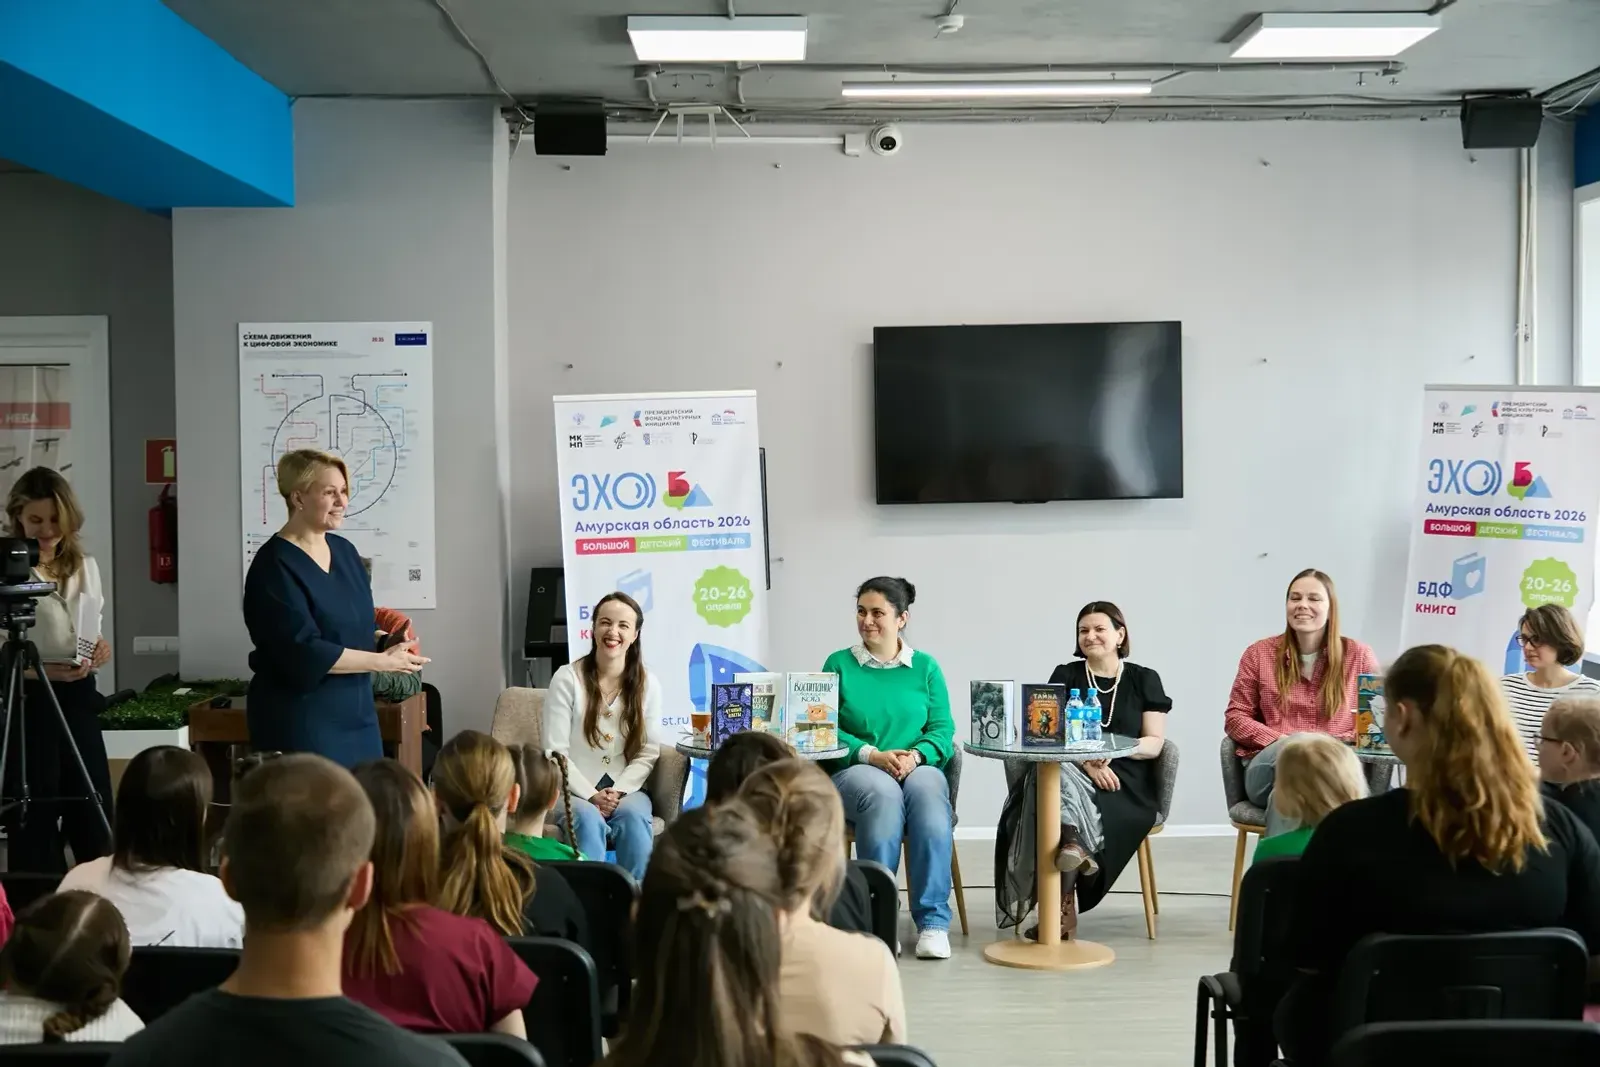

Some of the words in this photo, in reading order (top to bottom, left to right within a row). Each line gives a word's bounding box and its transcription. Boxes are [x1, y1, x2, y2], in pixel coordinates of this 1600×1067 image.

[1427, 459, 1498, 496] ЭХО
[572, 472, 652, 511] ЭХО
[1426, 503, 1491, 516] Амурская
[1494, 506, 1551, 519] область
[1554, 509, 1587, 522] 2026
[575, 520, 649, 534] Амурская
[653, 517, 714, 530] область
[717, 515, 751, 528] 2026
[1430, 522, 1471, 533] БОЛЬШОЙ
[1479, 525, 1518, 536] ДЕТСКИЙ
[1525, 528, 1579, 540] ФЕСТИВАЛЬ
[583, 540, 630, 551] БОЛЬШОЙ
[639, 538, 682, 549] ДЕТСКИЙ
[691, 537, 746, 548] ФЕСТИВАЛЬ
[1417, 581, 1453, 598] БДФ
[1526, 576, 1572, 593] 20-26
[700, 587, 747, 600] 20-26
[1529, 593, 1565, 603] апреля
[705, 602, 742, 613] апреля
[1415, 603, 1456, 616] книга
[1033, 691, 1058, 700] ТАЙНА
[662, 717, 689, 726] st.ru
